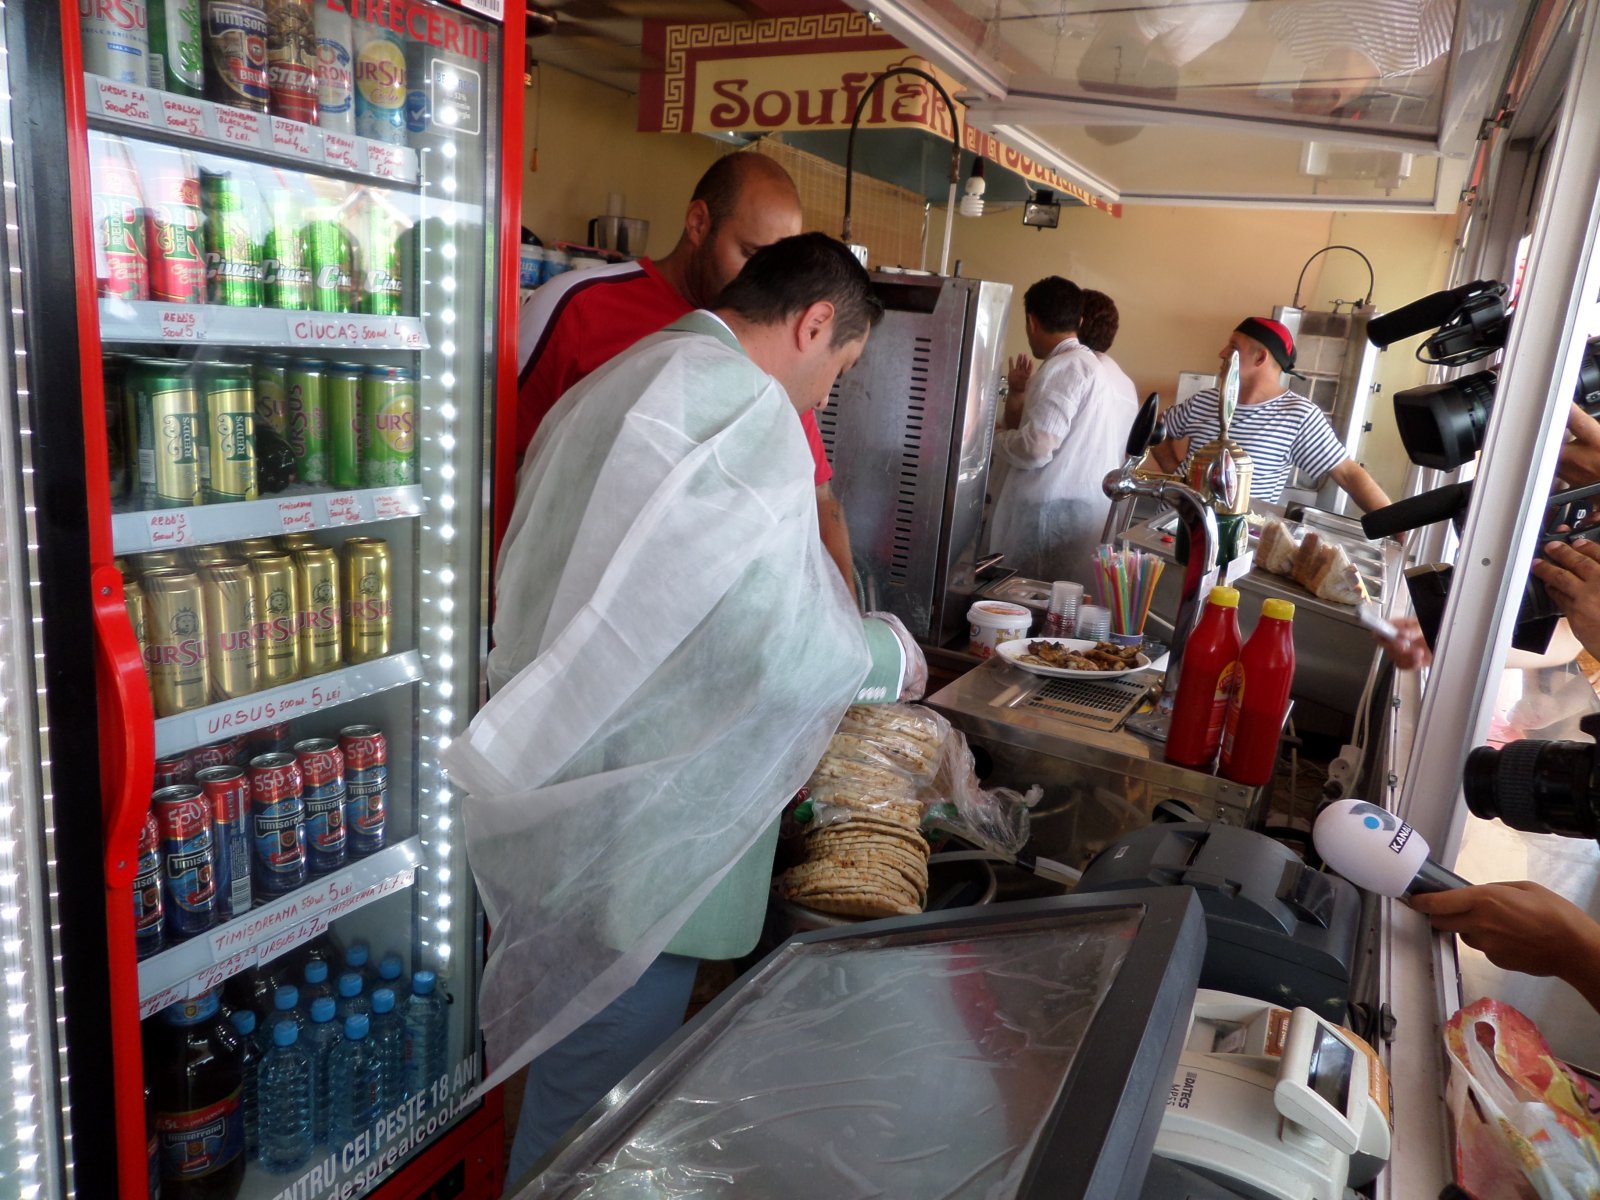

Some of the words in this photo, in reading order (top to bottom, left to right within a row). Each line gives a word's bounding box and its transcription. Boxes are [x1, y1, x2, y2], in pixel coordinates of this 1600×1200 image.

[225, 125, 234, 138] 5
[184, 325, 194, 337] 5
[182, 416, 193, 457] REDD'S
[235, 415, 246, 455] REDD'S
[175, 525, 186, 542] 5
[208, 702, 277, 735] URSUS
[311, 686, 324, 707] 5
[303, 753, 332, 776] 550
[254, 770, 285, 793] 550
[168, 801, 201, 829] 550
[329, 882, 339, 902] 5
[260, 930, 296, 959] URSUS
[307, 917, 320, 938] 7
[205, 972, 223, 991] 10
[1178, 1077, 1197, 1109] DATECS
[342, 1128, 370, 1174] CEI
[375, 1088, 426, 1150] PESTE
[430, 1073, 449, 1108] 18
[452, 1052, 478, 1093] ANI
